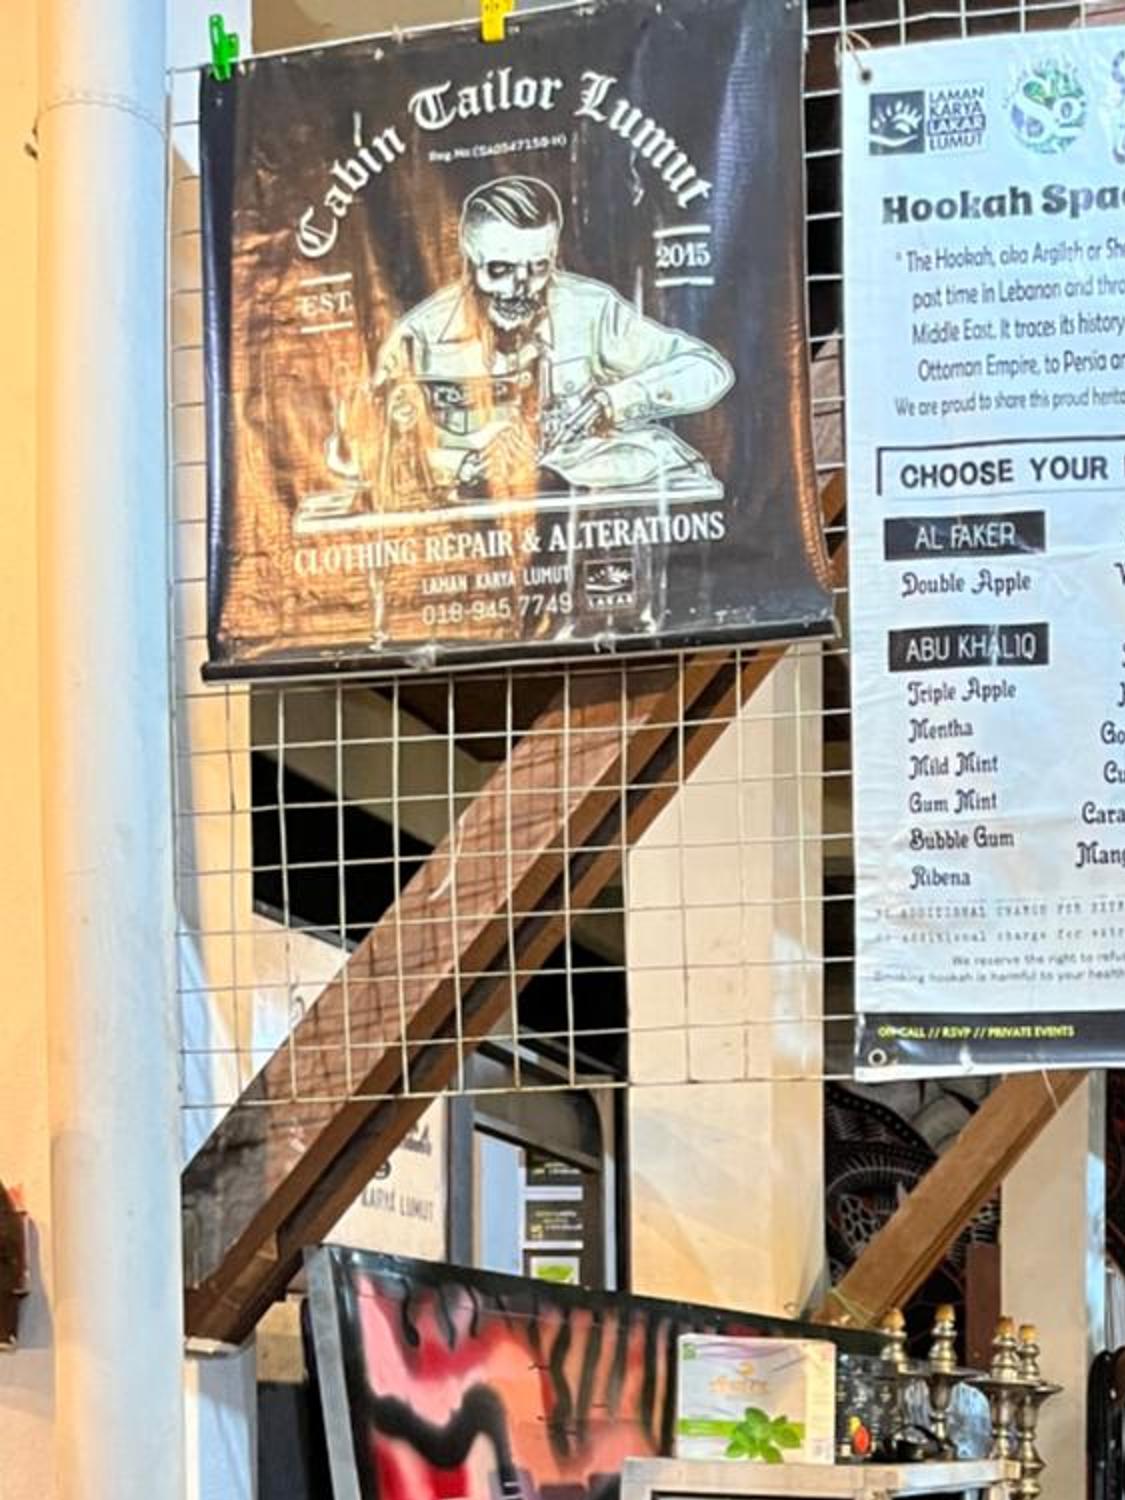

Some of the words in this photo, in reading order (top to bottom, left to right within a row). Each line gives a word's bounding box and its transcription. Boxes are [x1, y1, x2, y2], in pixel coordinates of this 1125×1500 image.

[928, 100, 983, 117] KARYA
[929, 87, 985, 103] LAMAN
[929, 116, 984, 134] LAKAR
[928, 132, 983, 151] LUMUT
[296, 125, 406, 258] Cabin
[408, 67, 563, 130] Tailor
[574, 70, 713, 208] Lumut
[881, 186, 1033, 224] Hookah
[655, 241, 711, 267] 2015
[907, 250, 932, 272] The
[1087, 245, 1101, 261] or
[913, 288, 942, 312] past
[946, 284, 977, 308] time
[981, 283, 996, 304] in
[999, 277, 1061, 302] Lebanon
[1065, 275, 1092, 297] and
[912, 319, 960, 344] Middle
[1014, 314, 1057, 338] traces
[1060, 313, 1075, 335] its
[918, 357, 982, 382] Ottoman
[1044, 353, 1060, 374] to
[1063, 348, 1107, 373] Persia
[894, 396, 916, 417] We
[918, 400, 938, 417] are
[941, 394, 977, 420] proud
[979, 393, 992, 412] to
[995, 389, 1026, 411] share
[1052, 385, 1091, 412] proud
[900, 457, 1016, 488] CHOOSE
[1030, 454, 1109, 483] YOUR
[293, 537, 418, 577] CLOTHING
[424, 529, 514, 562] REPAIR
[520, 527, 542, 553] &
[549, 511, 726, 552] ALTERATIONS
[914, 527, 944, 550] AL
[951, 521, 1017, 548] FAKER
[422, 574, 468, 595] LAMAN
[475, 571, 517, 590] KARYA
[523, 565, 572, 586] LUMUT
[902, 570, 966, 598] Double
[971, 568, 1032, 597] Apple
[421, 597, 512, 625] 018-945
[519, 591, 574, 616] 7749
[905, 635, 950, 663] ABU
[957, 631, 1037, 660] KHALIQ
[907, 680, 957, 707] Triple
[961, 676, 1018, 702] Apple
[907, 717, 974, 744] Mentha
[908, 754, 950, 781] Mild
[954, 751, 999, 778] Mint
[908, 791, 949, 814] Gum
[953, 787, 998, 814] Mint
[908, 827, 969, 851] Bubble
[973, 824, 1016, 849] Gum
[909, 864, 972, 890] Ribena
